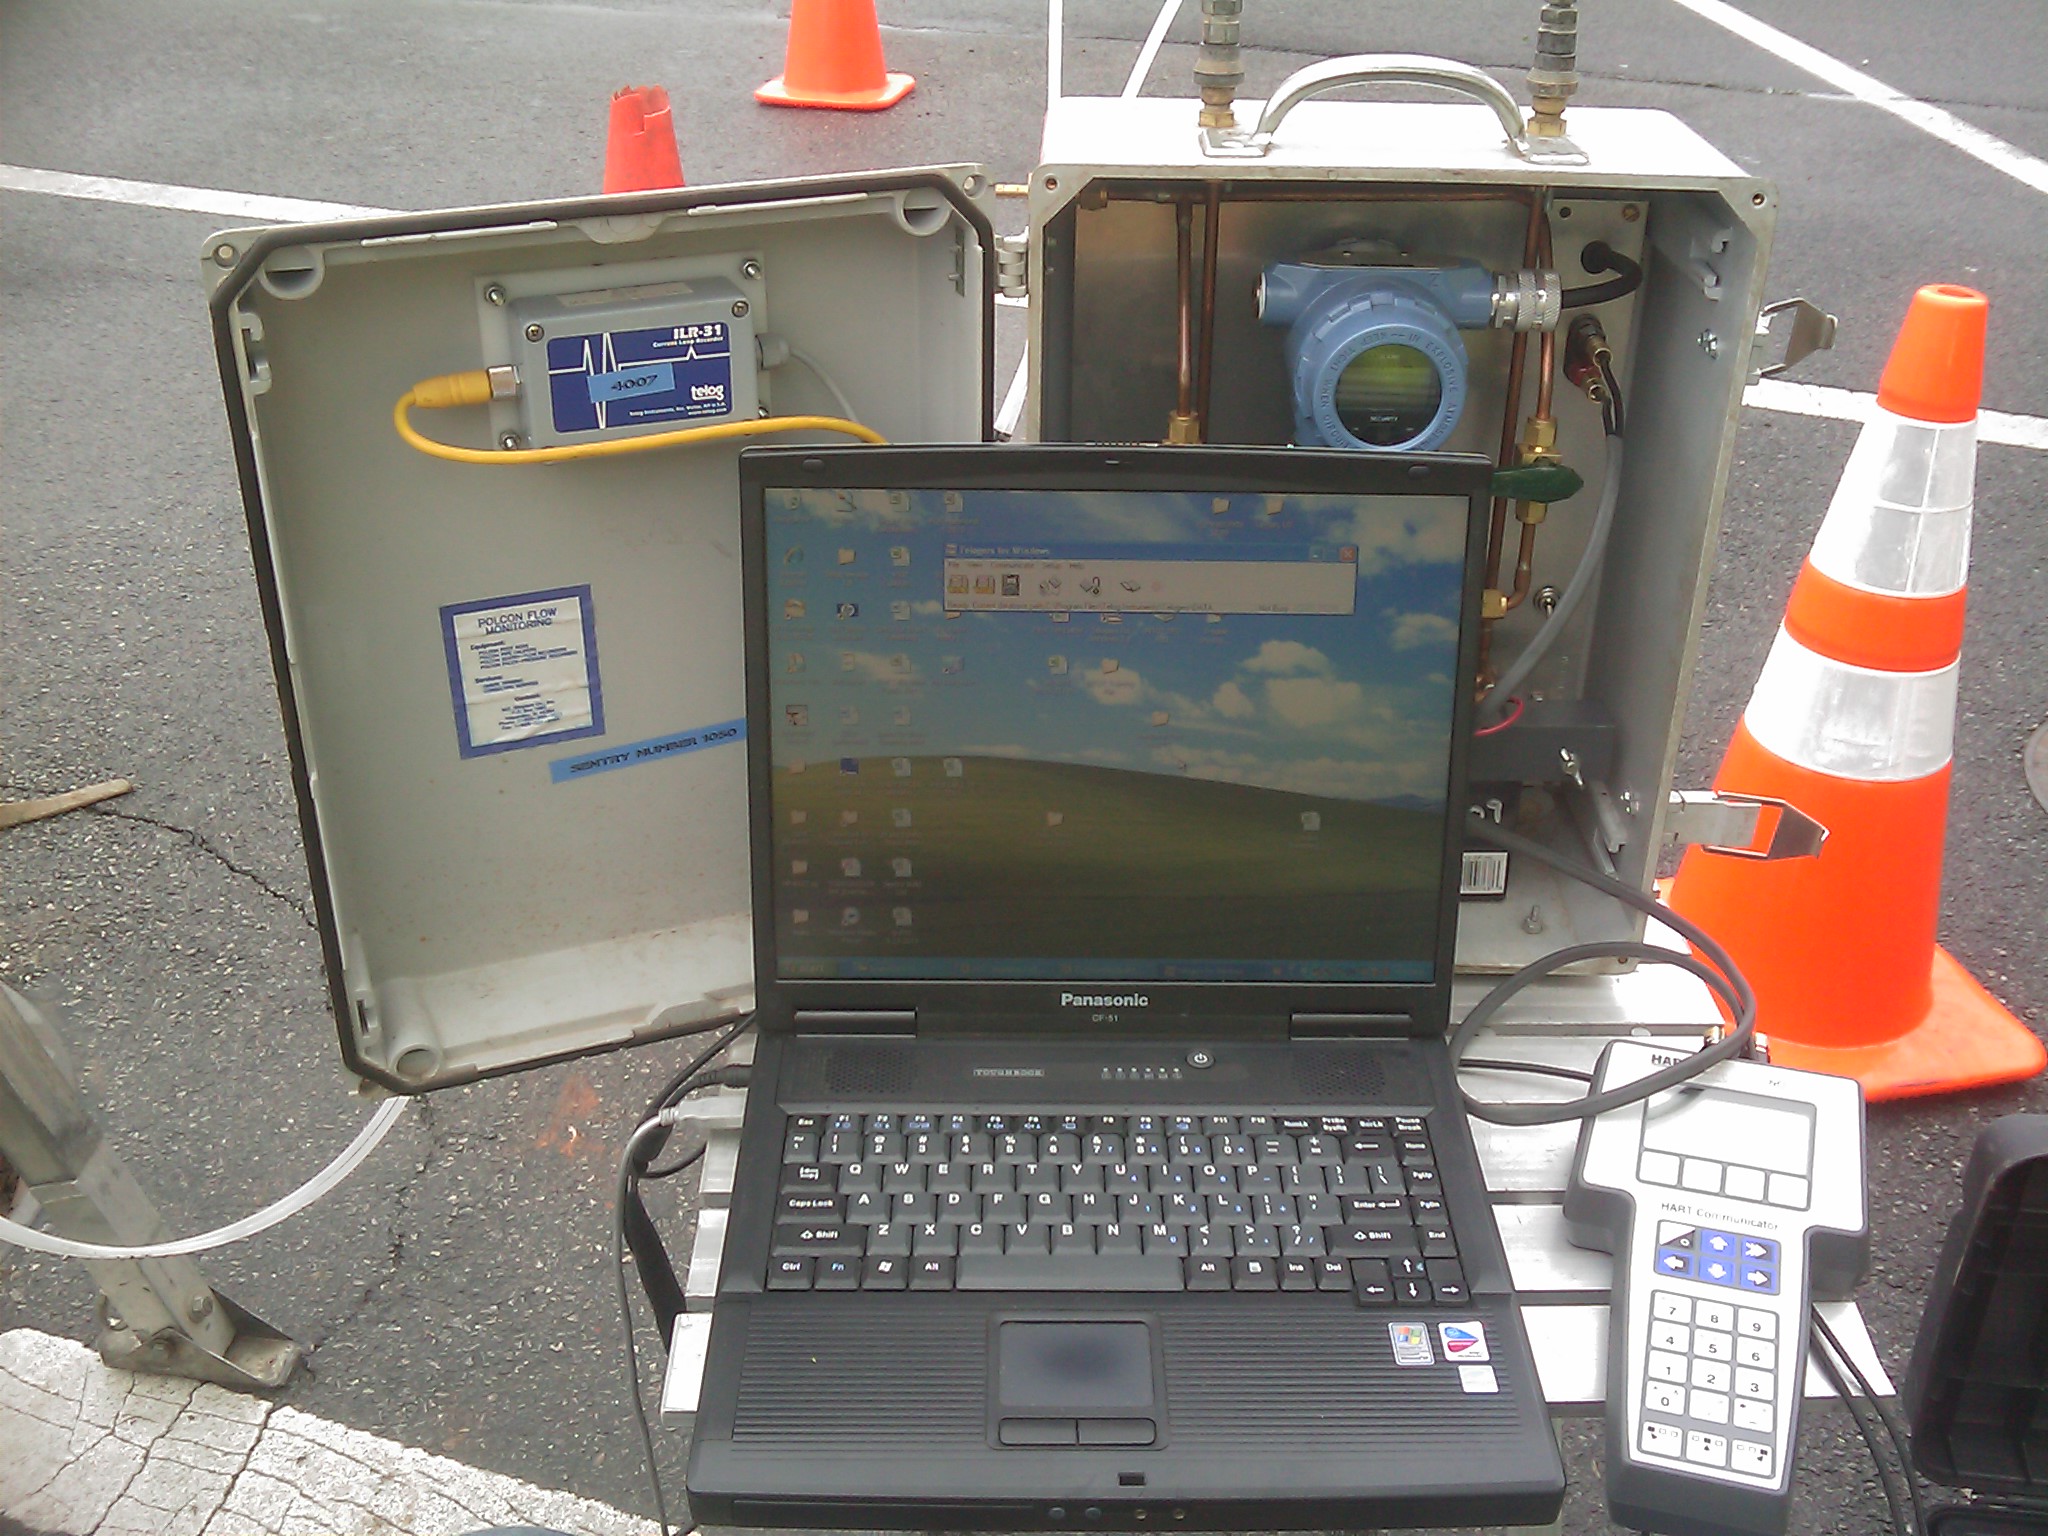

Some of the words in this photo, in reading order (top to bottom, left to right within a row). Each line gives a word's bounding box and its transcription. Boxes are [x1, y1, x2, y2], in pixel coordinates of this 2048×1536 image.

[673, 324, 722, 340] ILR-31
[611, 374, 658, 391] 4007
[691, 384, 725, 401] telog
[477, 613, 523, 628] POLCON
[527, 607, 558, 621] FLOW
[485, 618, 553, 636] MONITORING
[570, 752, 630, 773] SENTRY
[637, 736, 698, 759] NUMBER
[702, 727, 738, 743] 1050
[1060, 992, 1149, 1008] Panasonic
[1092, 1014, 1119, 1023] CF-51
[1651, 1054, 1683, 1066] HAR
[798, 1118, 814, 1126] Esc
[850, 1164, 862, 1175] Q
[894, 1164, 909, 1174] W
[938, 1164, 948, 1174] E
[982, 1164, 994, 1174] R
[1027, 1164, 1038, 1174] T
[1072, 1164, 1083, 1175] Y
[1115, 1164, 1126, 1175] U
[1162, 1165, 1168, 1175] I
[1204, 1165, 1216, 1175] O
[1247, 1165, 1258, 1175] P
[789, 1199, 811, 1208] Caps
[812, 1199, 834, 1207] Lock
[858, 1194, 870, 1205] A
[904, 1194, 914, 1204] S
[949, 1194, 960, 1204] D
[994, 1193, 1003, 1204] F
[1038, 1194, 1051, 1204] G
[1084, 1194, 1095, 1205] H
[1129, 1194, 1138, 1205] J
[1173, 1194, 1185, 1205] K
[1218, 1194, 1228, 1205] L
[1661, 1202, 1692, 1214] HART
[1696, 1208, 1778, 1230] Communicator
[816, 1230, 839, 1239] Shift
[878, 1224, 890, 1235] Z
[924, 1224, 936, 1235] X
[970, 1224, 982, 1235] C
[1016, 1224, 1028, 1235] V
[1062, 1224, 1073, 1235] B
[1108, 1224, 1120, 1235] N
[1153, 1224, 1167, 1236] M
[1369, 1232, 1391, 1240] Shift
[1428, 1231, 1446, 1239] End
[782, 1263, 801, 1271] Ctrl
[831, 1263, 844, 1271] Fn
[924, 1262, 939, 1271] Alt
[1201, 1263, 1215, 1272] Alt
[1289, 1264, 1304, 1272] Ins
[1325, 1263, 1342, 1272] Del
[1668, 1306, 1677, 1315] 7
[1710, 1314, 1719, 1324] 8
[1752, 1323, 1762, 1332] 9
[1666, 1336, 1674, 1345] 4
[1709, 1344, 1718, 1354] 5
[1752, 1352, 1760, 1362] 6
[1666, 1366, 1672, 1375] 1
[1706, 1374, 1716, 1384] 2
[1750, 1383, 1759, 1393] 3
[1661, 1396, 1670, 1407] 0
